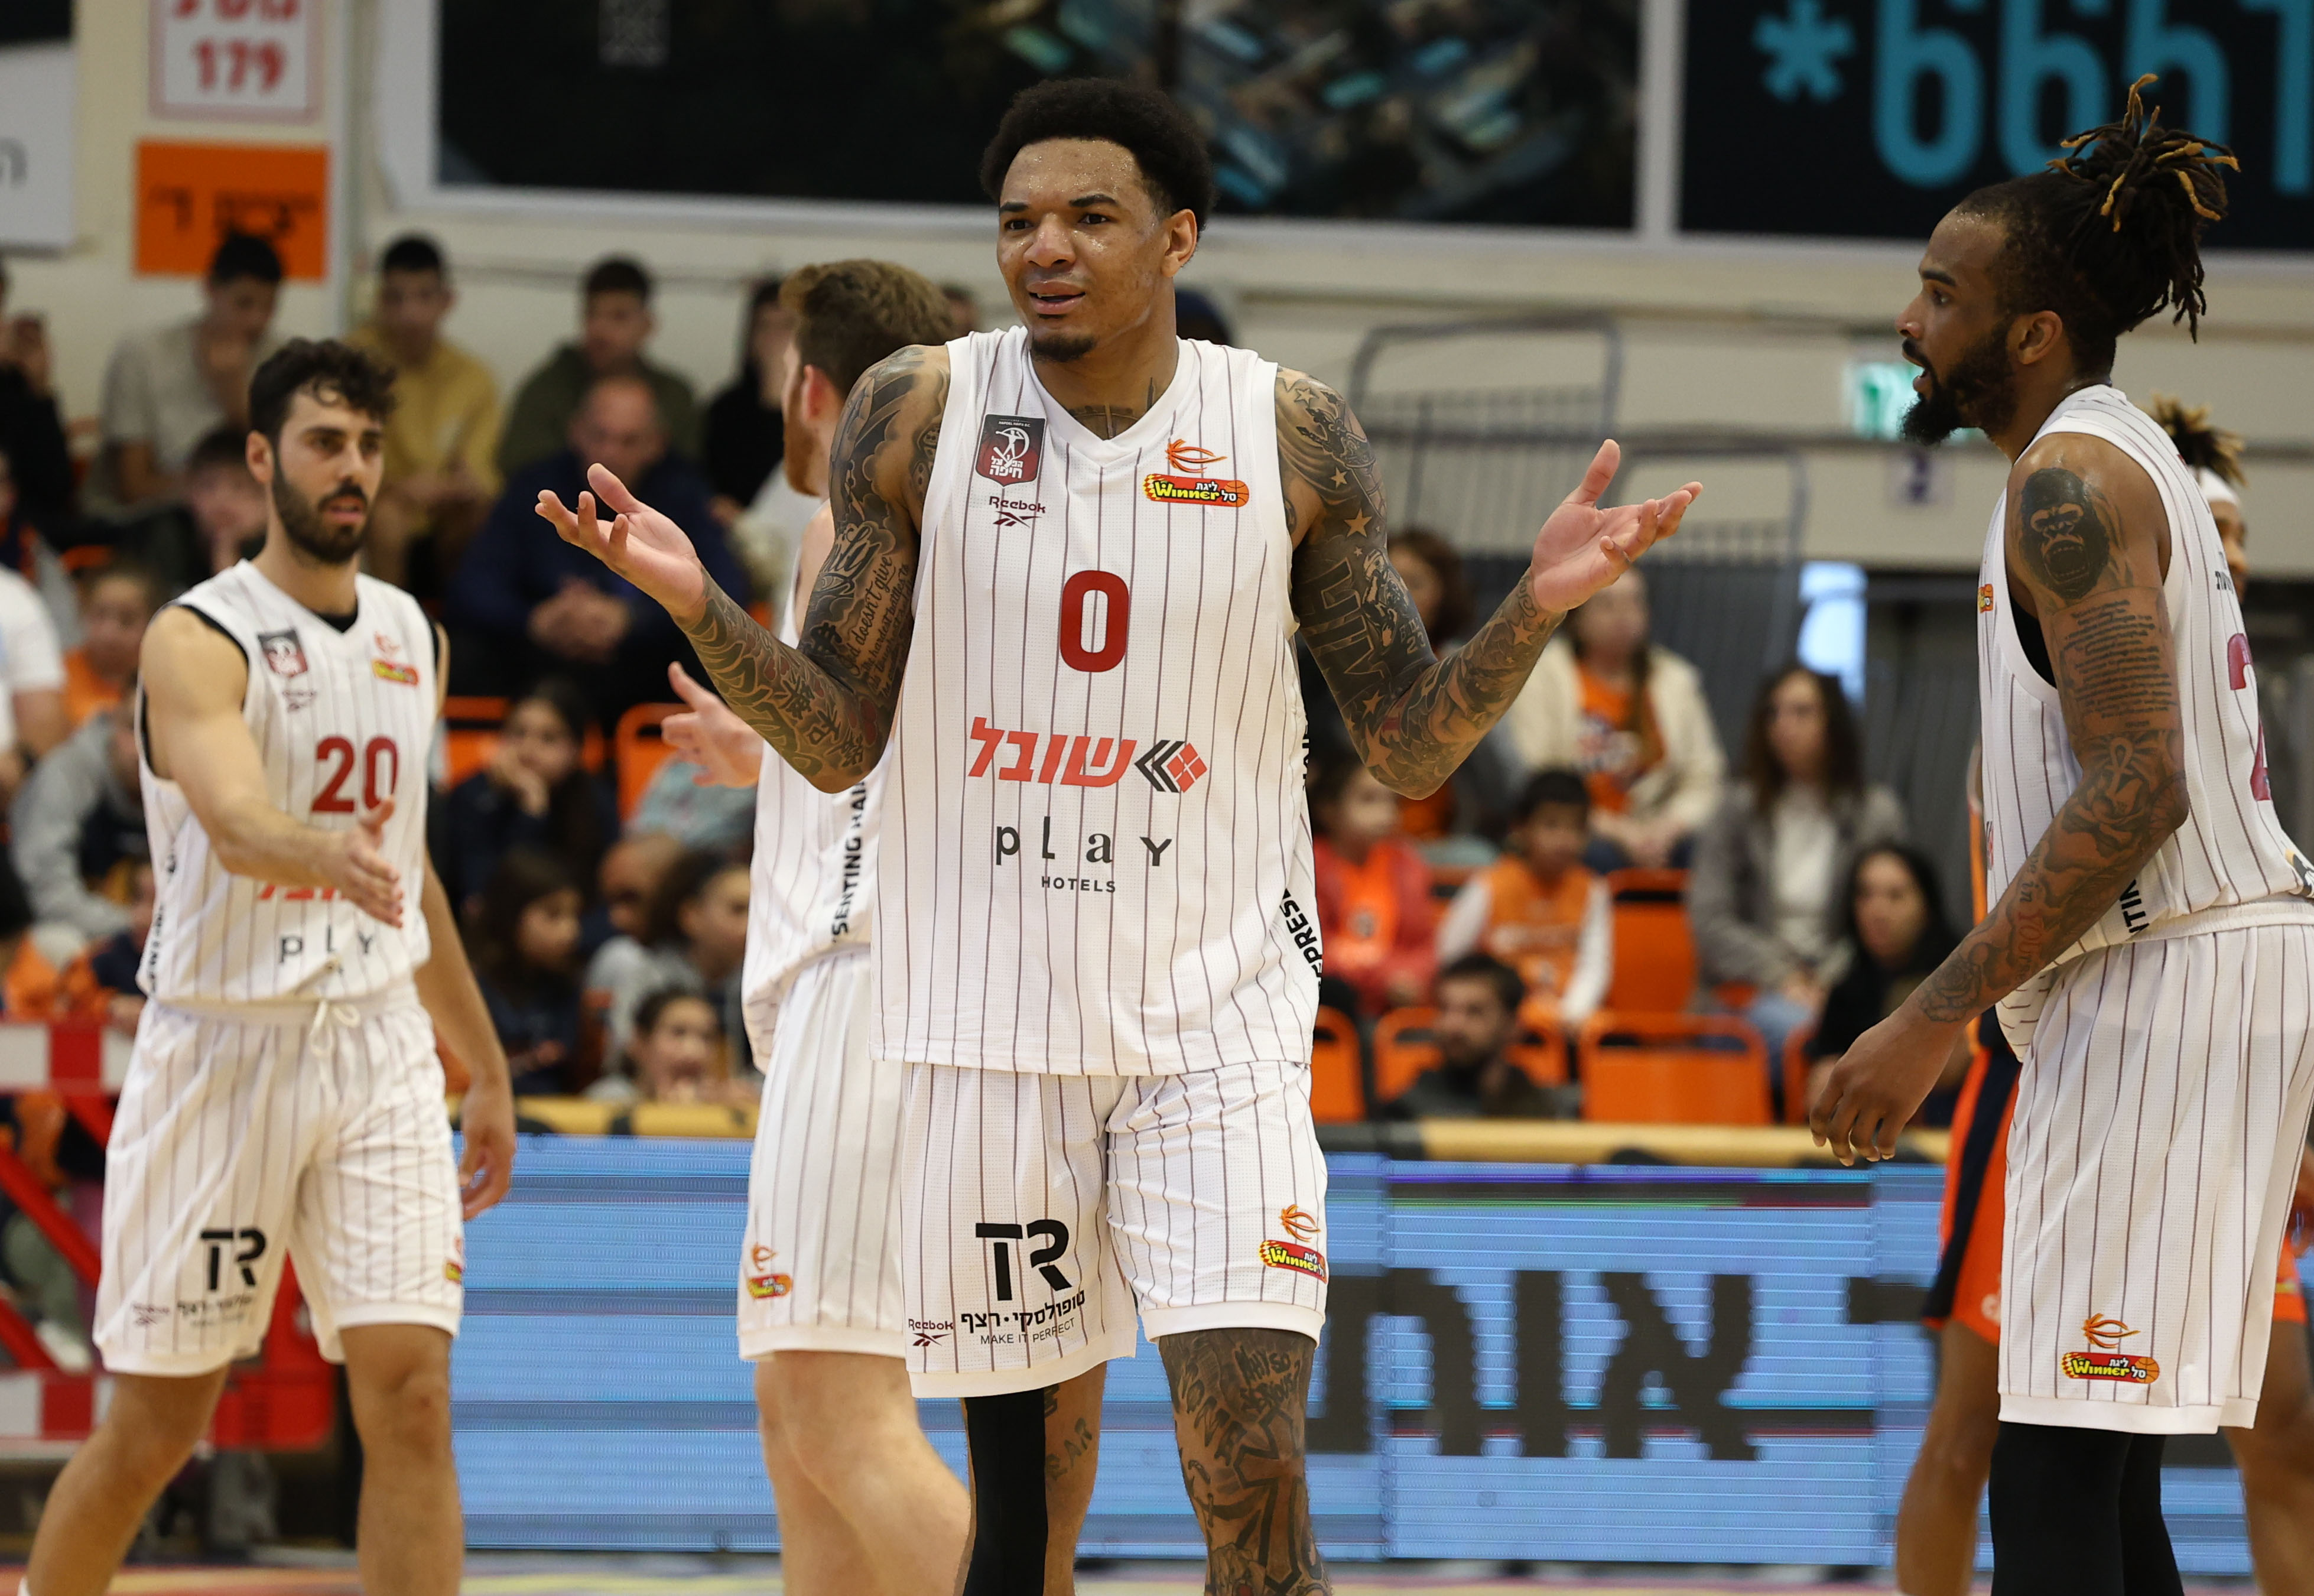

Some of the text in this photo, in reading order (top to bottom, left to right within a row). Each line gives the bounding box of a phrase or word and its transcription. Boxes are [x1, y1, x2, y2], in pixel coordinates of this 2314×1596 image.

[989, 465, 1023, 479] חיפה
[1154, 480, 1238, 502] Winner סל
[1195, 481, 1218, 491] ליגת
[989, 496, 1046, 513] Reebok
[852, 581, 882, 645] doesn't
[873, 556, 895, 593] give
[1060, 570, 1129, 672] 0
[967, 716, 1138, 787] שובל
[312, 736, 399, 812] 20
[831, 836, 862, 937] SENTING
[1041, 876, 1116, 893] HOTELS
[1269, 1247, 1319, 1273] Winner
[961, 1290, 1086, 1334] טופולסקי רצף
[908, 1318, 954, 1331] Reebok
[980, 1318, 1075, 1344] MAKE IT PERFECT
[2071, 1358, 2148, 1379] Winner סל
[2109, 1357, 2130, 1367] ליגת
